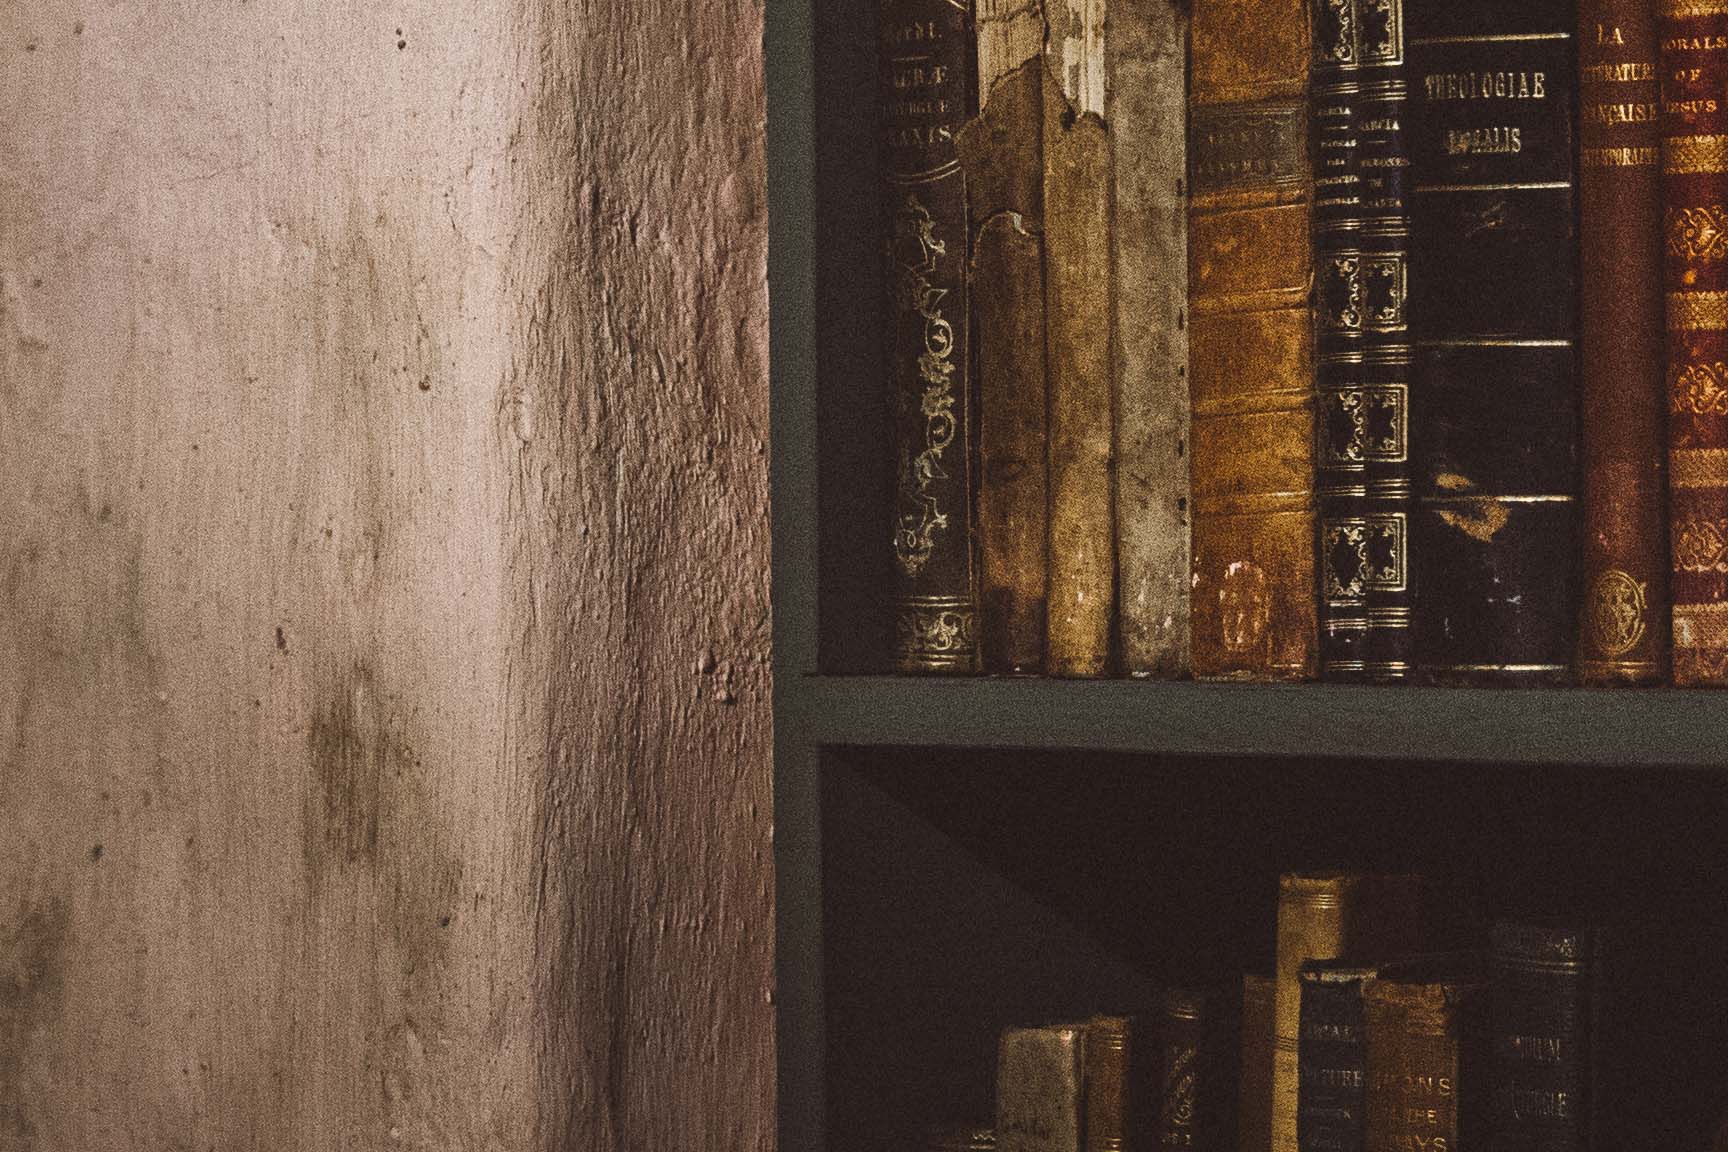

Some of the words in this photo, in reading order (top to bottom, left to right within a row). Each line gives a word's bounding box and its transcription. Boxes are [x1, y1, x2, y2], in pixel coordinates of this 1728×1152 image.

[1597, 23, 1625, 45] LA
[1424, 71, 1546, 100] THEOLOGIAE
[1675, 68, 1702, 82] OF
